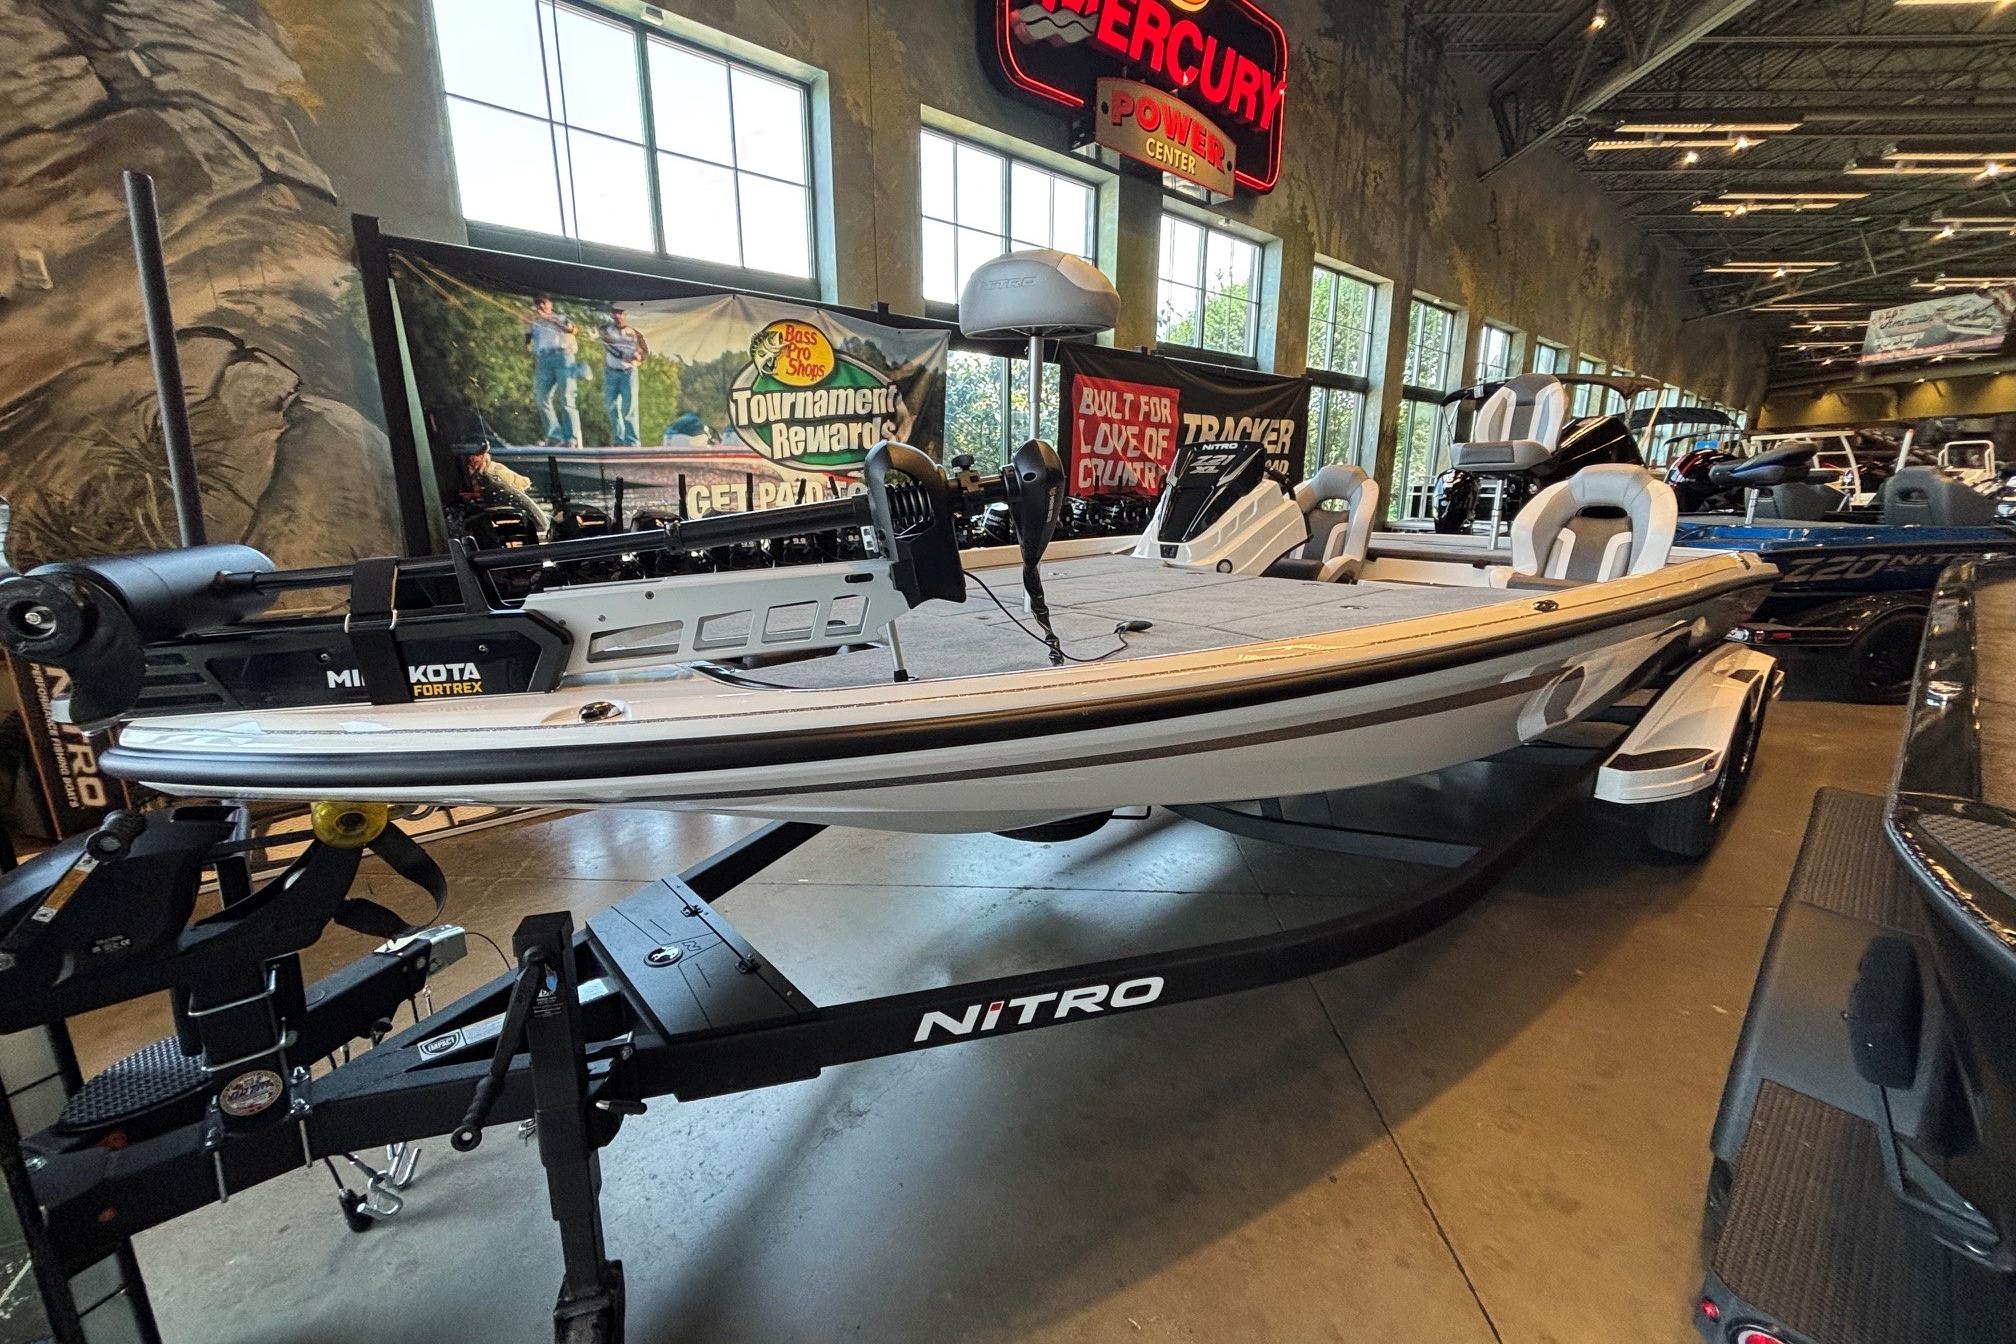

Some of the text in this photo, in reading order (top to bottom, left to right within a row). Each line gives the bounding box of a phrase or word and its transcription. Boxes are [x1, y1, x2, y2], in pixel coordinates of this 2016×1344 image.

[1111, 90, 1225, 175] POWER
[1146, 138, 1195, 175] CENTER
[785, 324, 817, 346] Bass
[786, 343, 811, 360] Pro
[786, 358, 825, 381] Shops
[732, 384, 897, 426] Tournament
[1079, 386, 1172, 424] BUILT FOR
[1078, 419, 1170, 461] LOVE OF
[1183, 413, 1295, 454] TRACKER
[1202, 443, 1239, 451] NITRO
[1190, 454, 1236, 467] Z21
[1190, 466, 1219, 474] XL
[687, 483, 747, 519] GET
[759, 481, 823, 509] PAD
[1779, 553, 1890, 583] Z20
[327, 662, 482, 688] MI KOTA
[413, 681, 483, 696] FORTREX
[50, 738, 70, 775] FISHING
[62, 777, 80, 808] BOATS
[913, 976, 1165, 1042] NITRO
[427, 1035, 455, 1052] IMPACT
